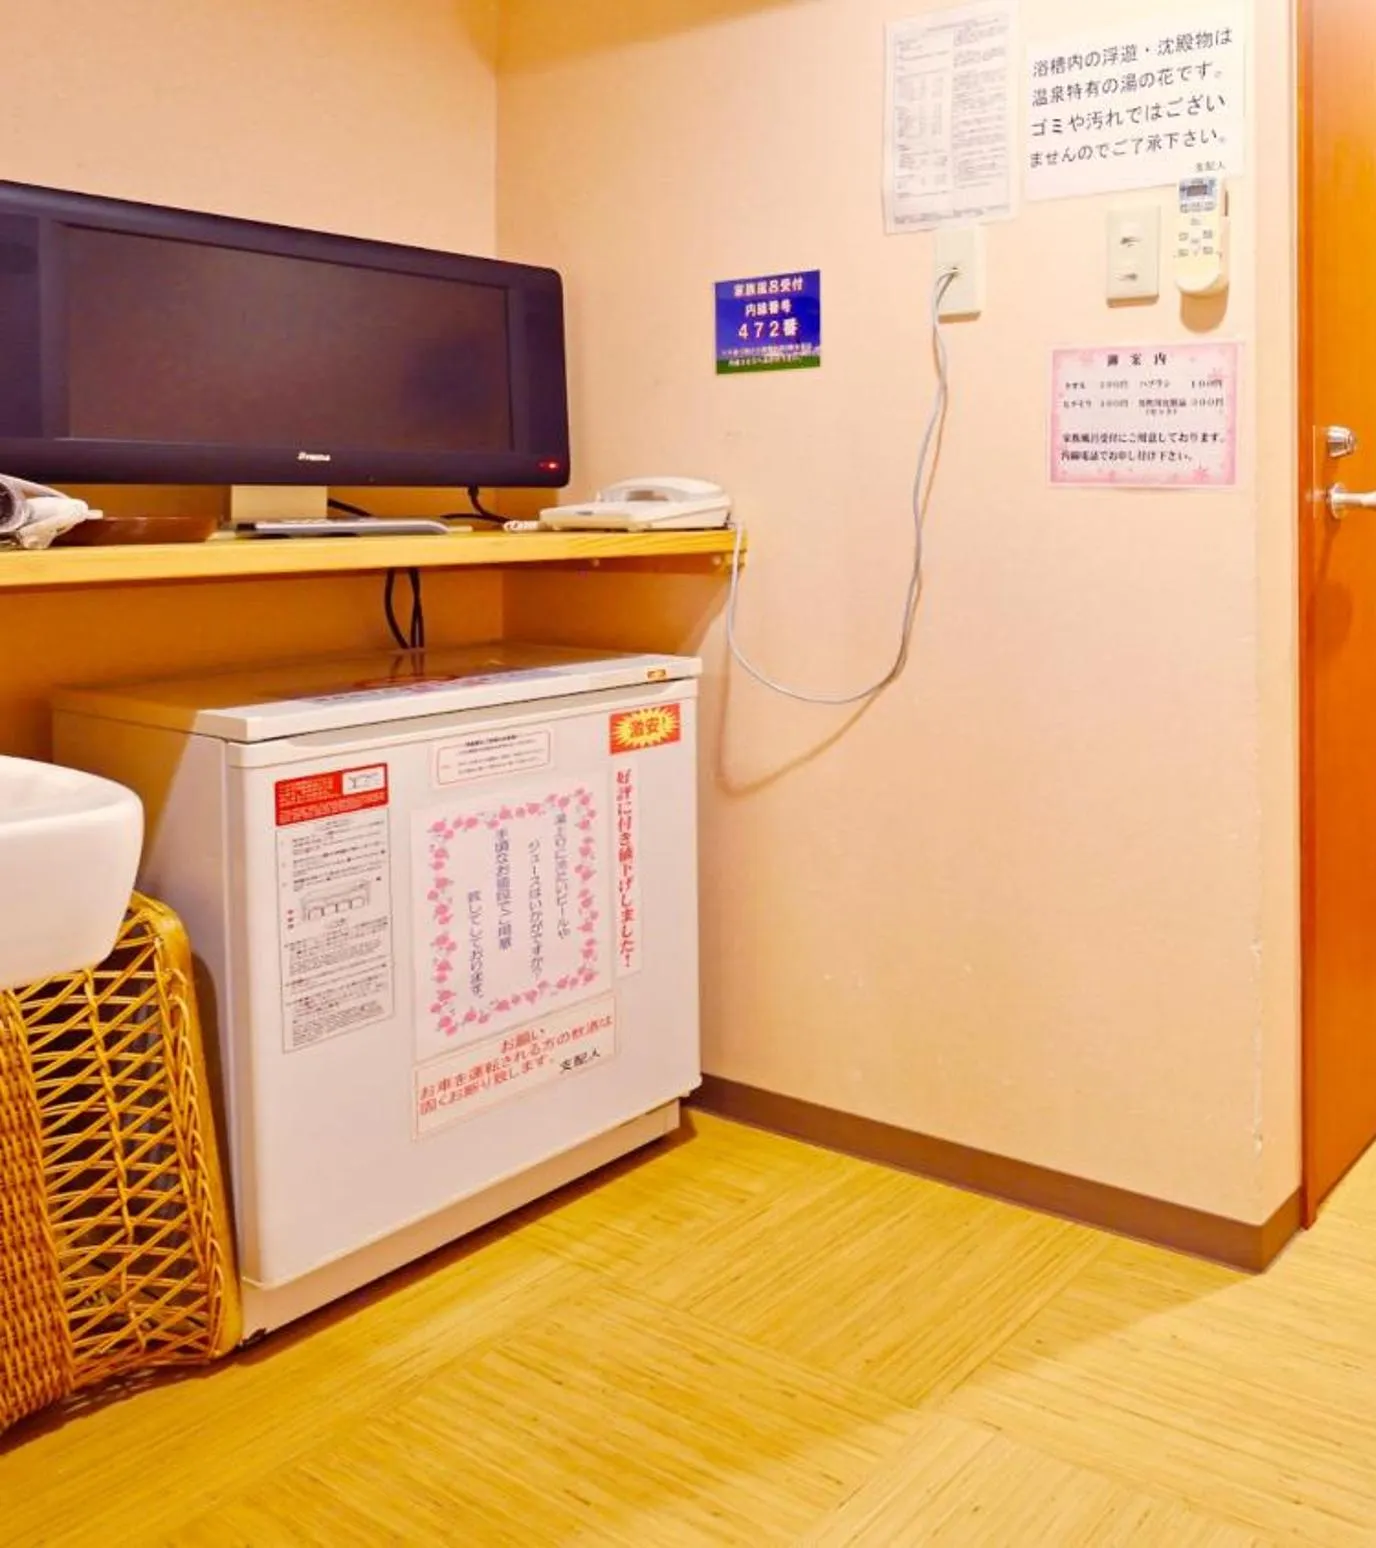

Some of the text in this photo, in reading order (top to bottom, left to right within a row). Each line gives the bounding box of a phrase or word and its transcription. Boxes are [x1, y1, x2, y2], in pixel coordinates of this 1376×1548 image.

[1033, 28, 1233, 78] 浴槽内の浮遊・沈殿物は
[1032, 61, 1223, 107] 温泉特有の湯の花です。
[1030, 94, 1226, 137] ゴミや汚れではござい
[1029, 129, 1227, 168] ませんのでご了承下さい。
[559, 1048, 600, 1074] 支配人
